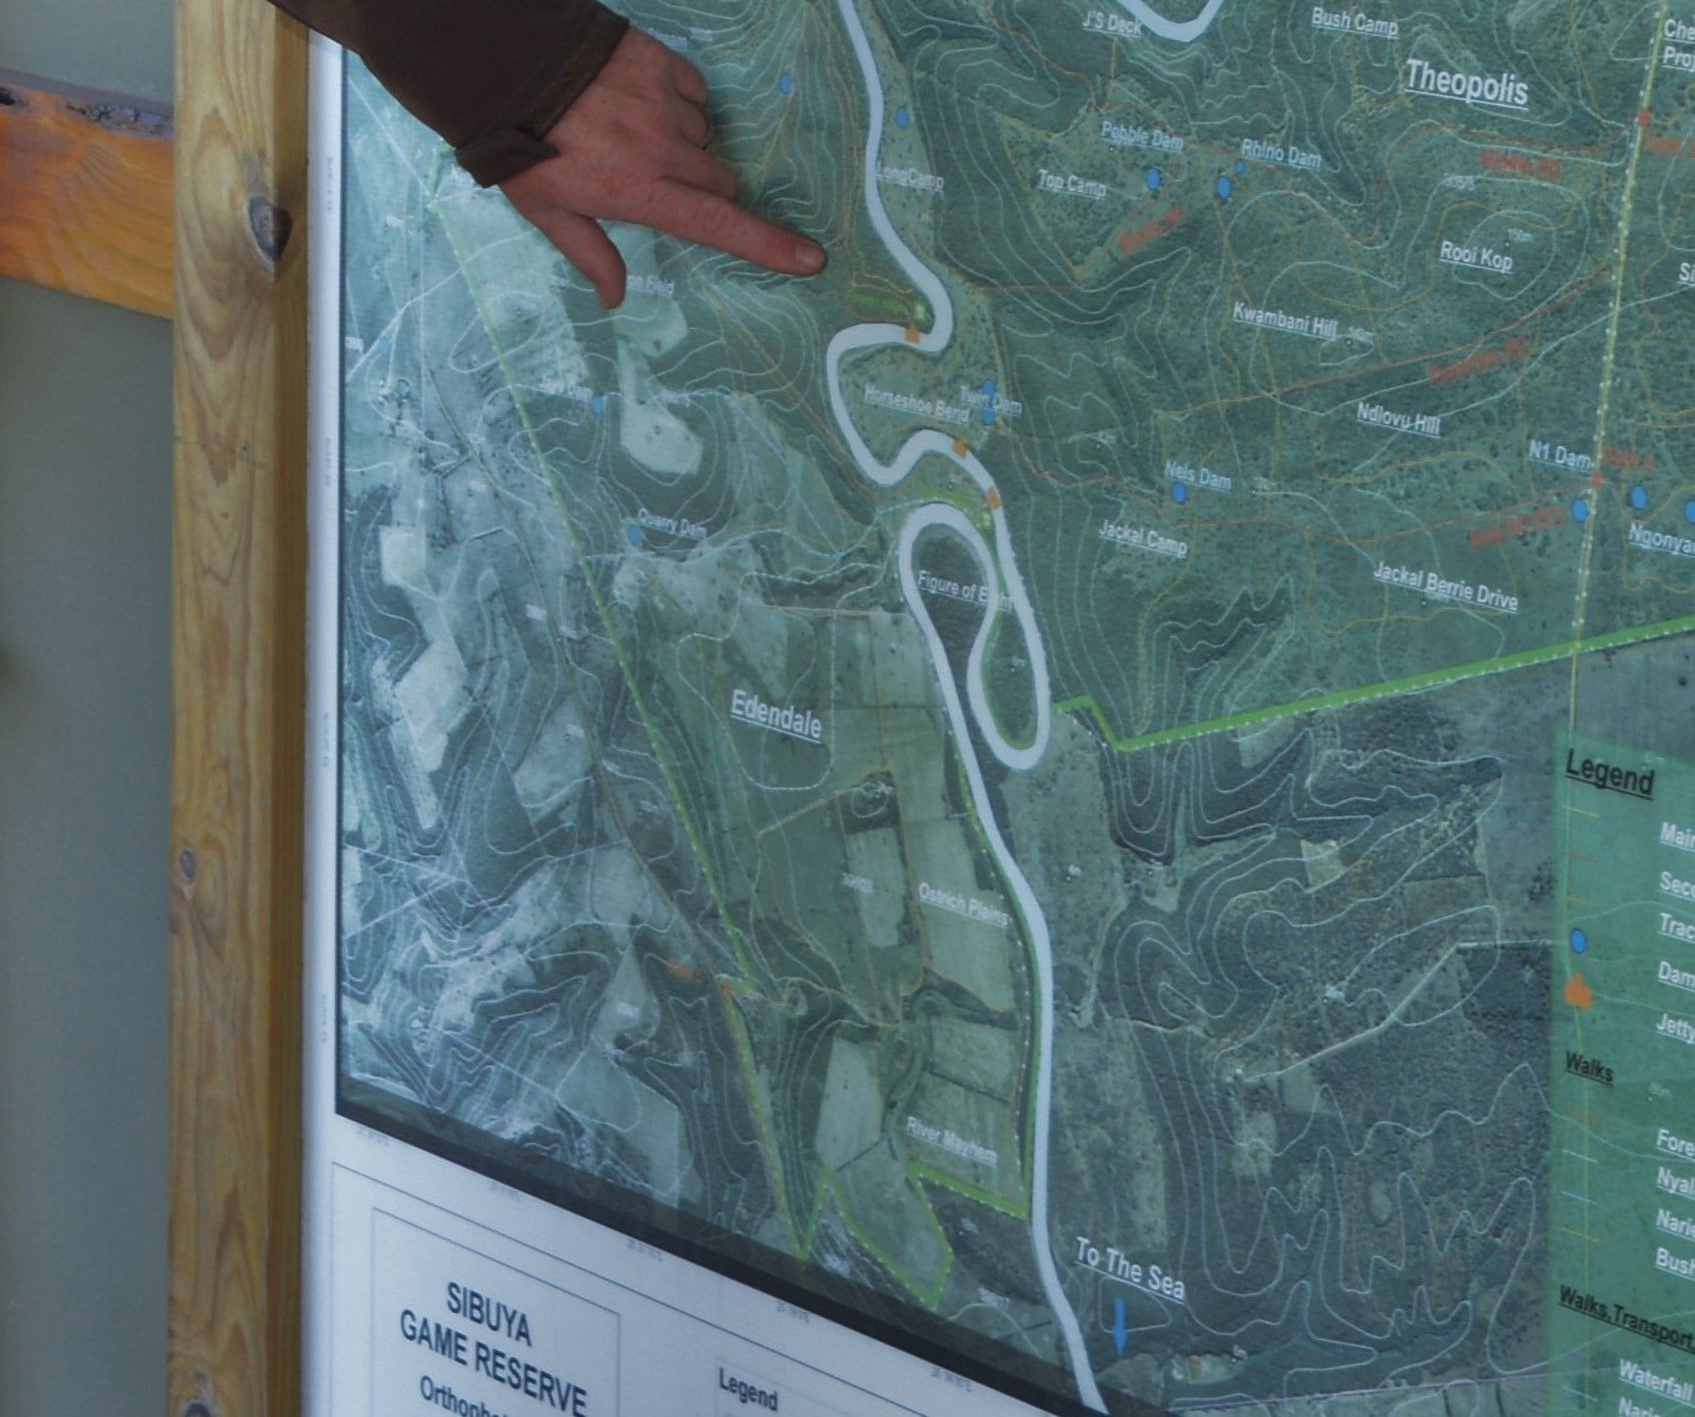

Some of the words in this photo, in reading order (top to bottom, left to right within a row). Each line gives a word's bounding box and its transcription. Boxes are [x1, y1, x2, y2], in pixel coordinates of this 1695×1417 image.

[1106, 16, 1142, 36] Deck
[1311, 7, 1350, 31] Bush
[1354, 12, 1398, 39] Camp
[1406, 58, 1529, 107] Theopolis
[1152, 128, 1184, 151] Dam
[1240, 137, 1283, 161] Rhino
[1287, 145, 1322, 167] Dam
[1038, 169, 1063, 190] Top
[1067, 177, 1106, 199] Camp
[1440, 241, 1477, 265] Rooi
[1480, 249, 1513, 273] Kop
[1233, 302, 1308, 333] Kwambani
[1311, 317, 1337, 338] Hill
[865, 384, 936, 416] Horseshoe
[938, 398, 970, 423] Bend
[1414, 415, 1440, 437] Hill
[1529, 440, 1553, 462] N1
[1556, 445, 1593, 469] Dam
[1196, 466, 1232, 490] Dam
[1099, 522, 1143, 547] Jackal
[1146, 529, 1188, 557] Camp
[918, 570, 959, 598] Figure
[961, 579, 978, 600] of
[1374, 563, 1423, 592] Jackal
[1427, 573, 1474, 601] Berrie
[1478, 586, 1519, 612] Drive
[732, 688, 822, 743] Edendale
[1566, 749, 1654, 795] Legend
[918, 883, 967, 913] Ostrich
[1566, 1051, 1614, 1083] Walks
[908, 1117, 940, 1146] River
[1076, 1235, 1101, 1266] To
[1105, 1247, 1145, 1283] The
[1149, 1265, 1186, 1299] Sea
[447, 1281, 531, 1347] SIBUYA
[400, 1309, 468, 1366] GAME
[475, 1340, 588, 1417] RESERVE
[719, 1367, 779, 1412] Legend
[1619, 1359, 1693, 1403] Waterfall
